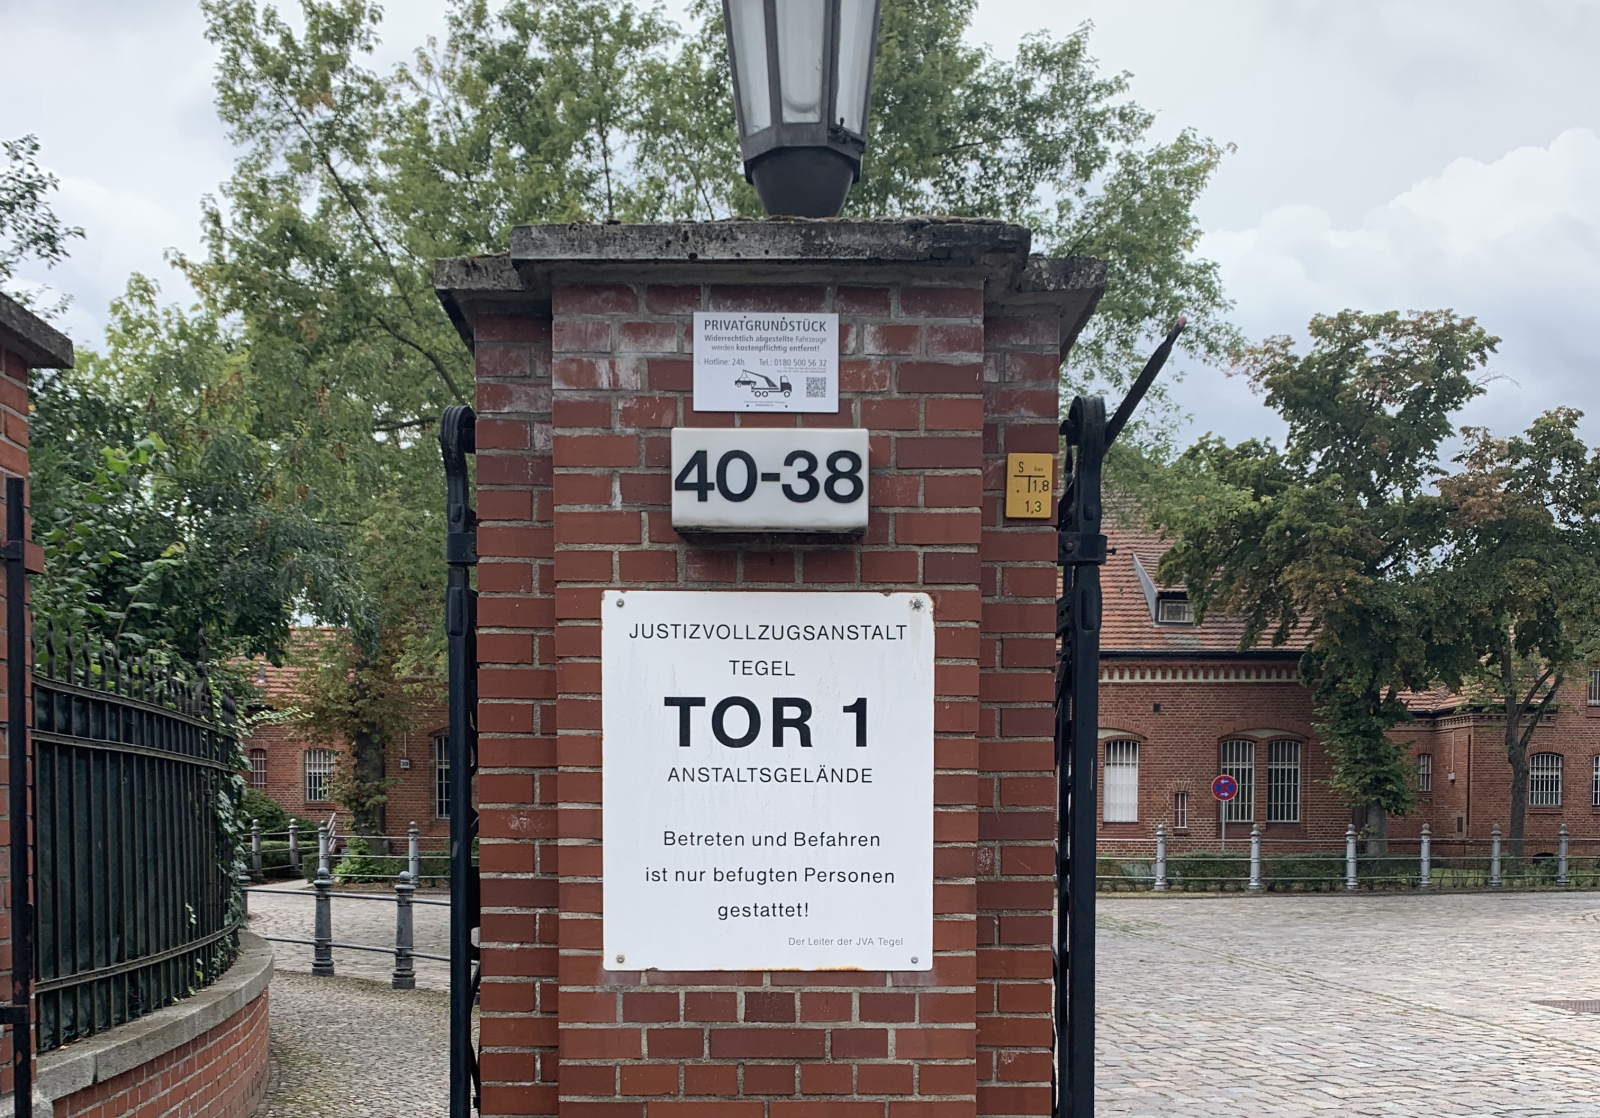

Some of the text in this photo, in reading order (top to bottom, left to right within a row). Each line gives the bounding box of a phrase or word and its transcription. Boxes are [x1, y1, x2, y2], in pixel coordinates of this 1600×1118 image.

[704, 319, 826, 332] PRIVATGRUNDSTÜCK
[795, 336, 827, 344] Fahrzeuge
[736, 344, 787, 353] kostenpflichtig
[731, 358, 745, 366] 24h
[1018, 461, 1024, 473] S
[675, 450, 864, 503] 40-38
[1025, 500, 1042, 514] 1,3
[629, 623, 907, 641] JUSTIZVOLLZUGSANSTALT
[729, 660, 795, 676] TEGEL
[664, 695, 868, 748] TOR 1
[667, 765, 873, 783] ANSTALTSGELÄNDE
[663, 831, 880, 847] Betreten und Befahren
[645, 867, 895, 885] ist nur befugten Personen
[718, 903, 809, 921] gestattet!
[788, 937, 904, 947] Der Leiter der JVA Tegel
